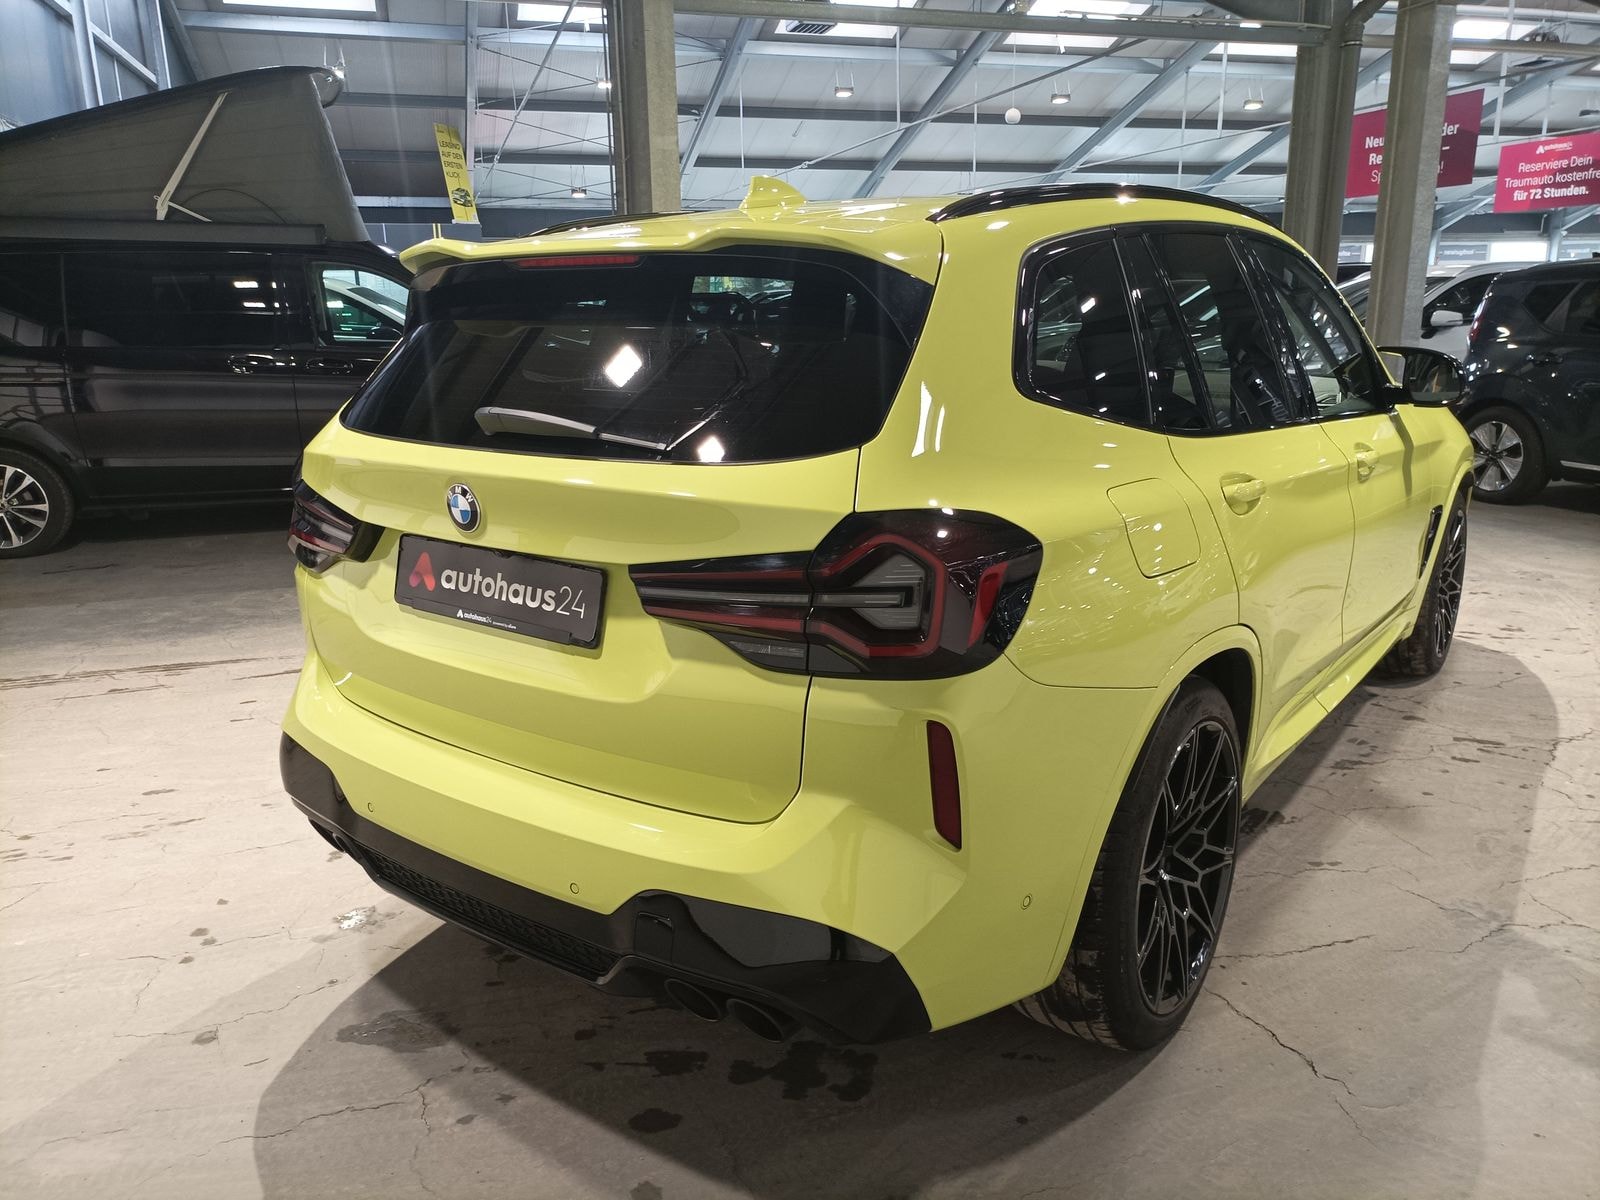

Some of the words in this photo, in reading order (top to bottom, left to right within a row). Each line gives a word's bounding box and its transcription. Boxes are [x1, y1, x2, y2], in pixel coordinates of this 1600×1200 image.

[443, 161, 463, 169] ERSTEN
[1518, 159, 1569, 173] Reserviere
[1570, 154, 1593, 167] Dein
[1504, 175, 1554, 188] Traumauto
[1513, 190, 1528, 201] für
[1529, 188, 1542, 200] 72
[1543, 184, 1589, 199] Stunden.
[447, 485, 474, 503] BMW
[440, 567, 586, 619] autohaus24
